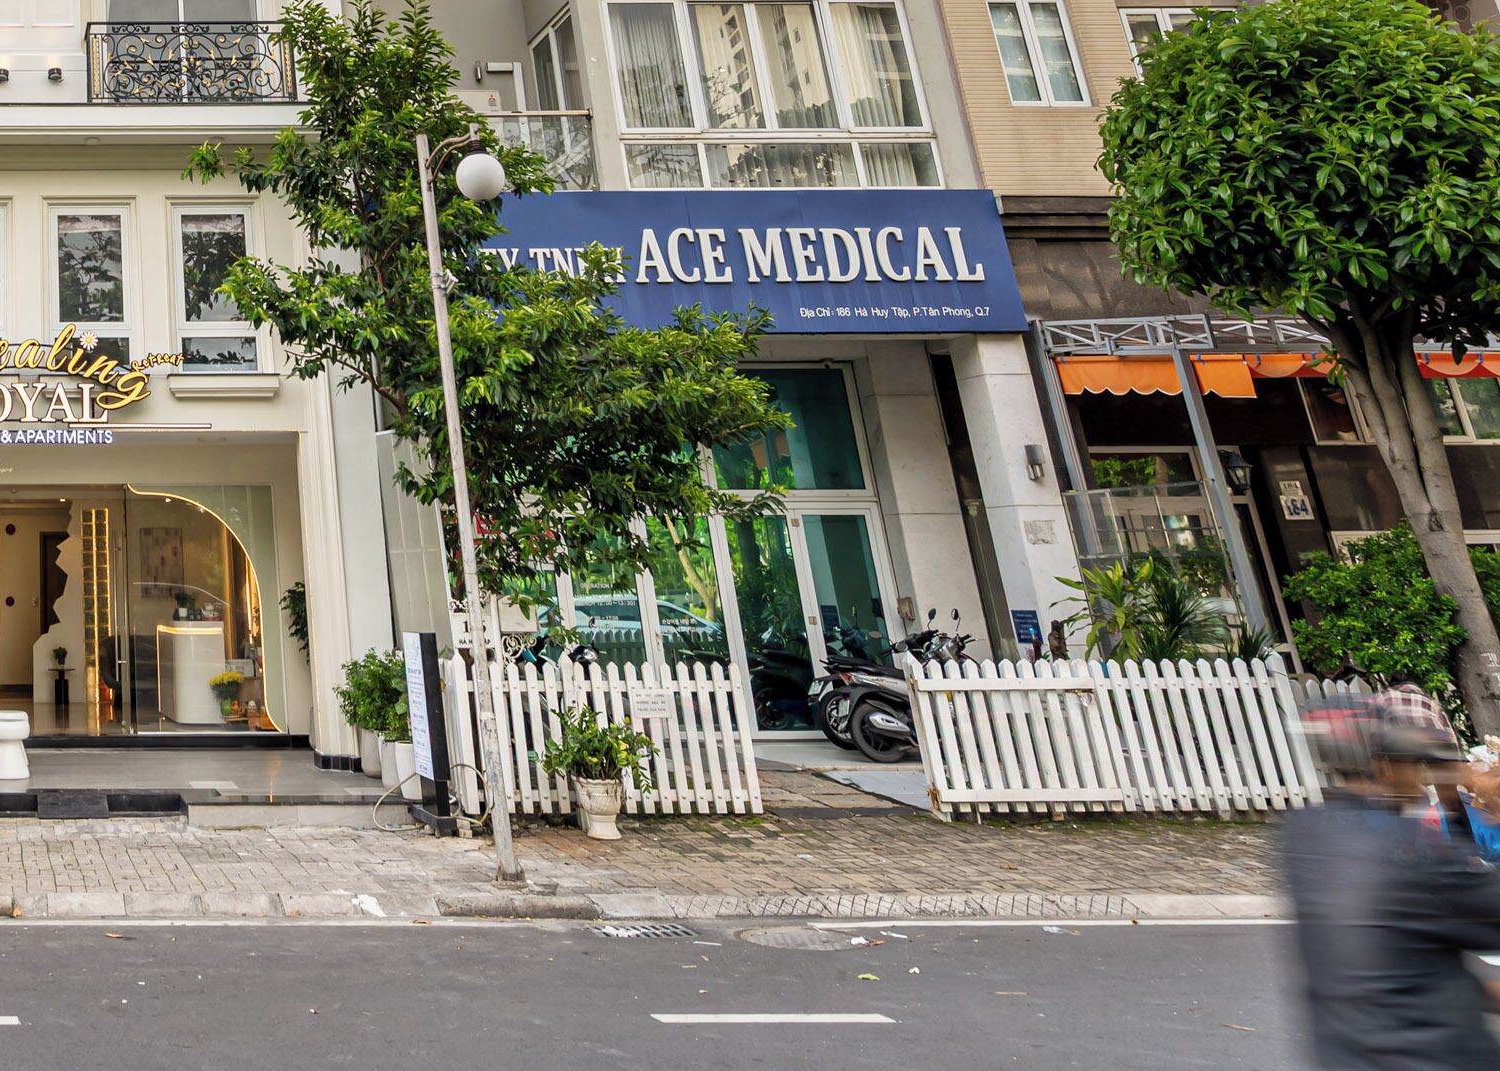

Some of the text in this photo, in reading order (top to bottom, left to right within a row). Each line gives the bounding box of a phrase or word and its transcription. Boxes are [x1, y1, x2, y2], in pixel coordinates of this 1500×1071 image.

[635, 227, 733, 284] ACE
[738, 226, 986, 283] MEDICAL
[800, 307, 815, 319] Địa
[836, 307, 851, 317] 186
[871, 307, 889, 319] Huy
[891, 306, 911, 319] Tập,
[942, 307, 974, 319] Phong,
[14, 429, 113, 444] APARTMENTS
